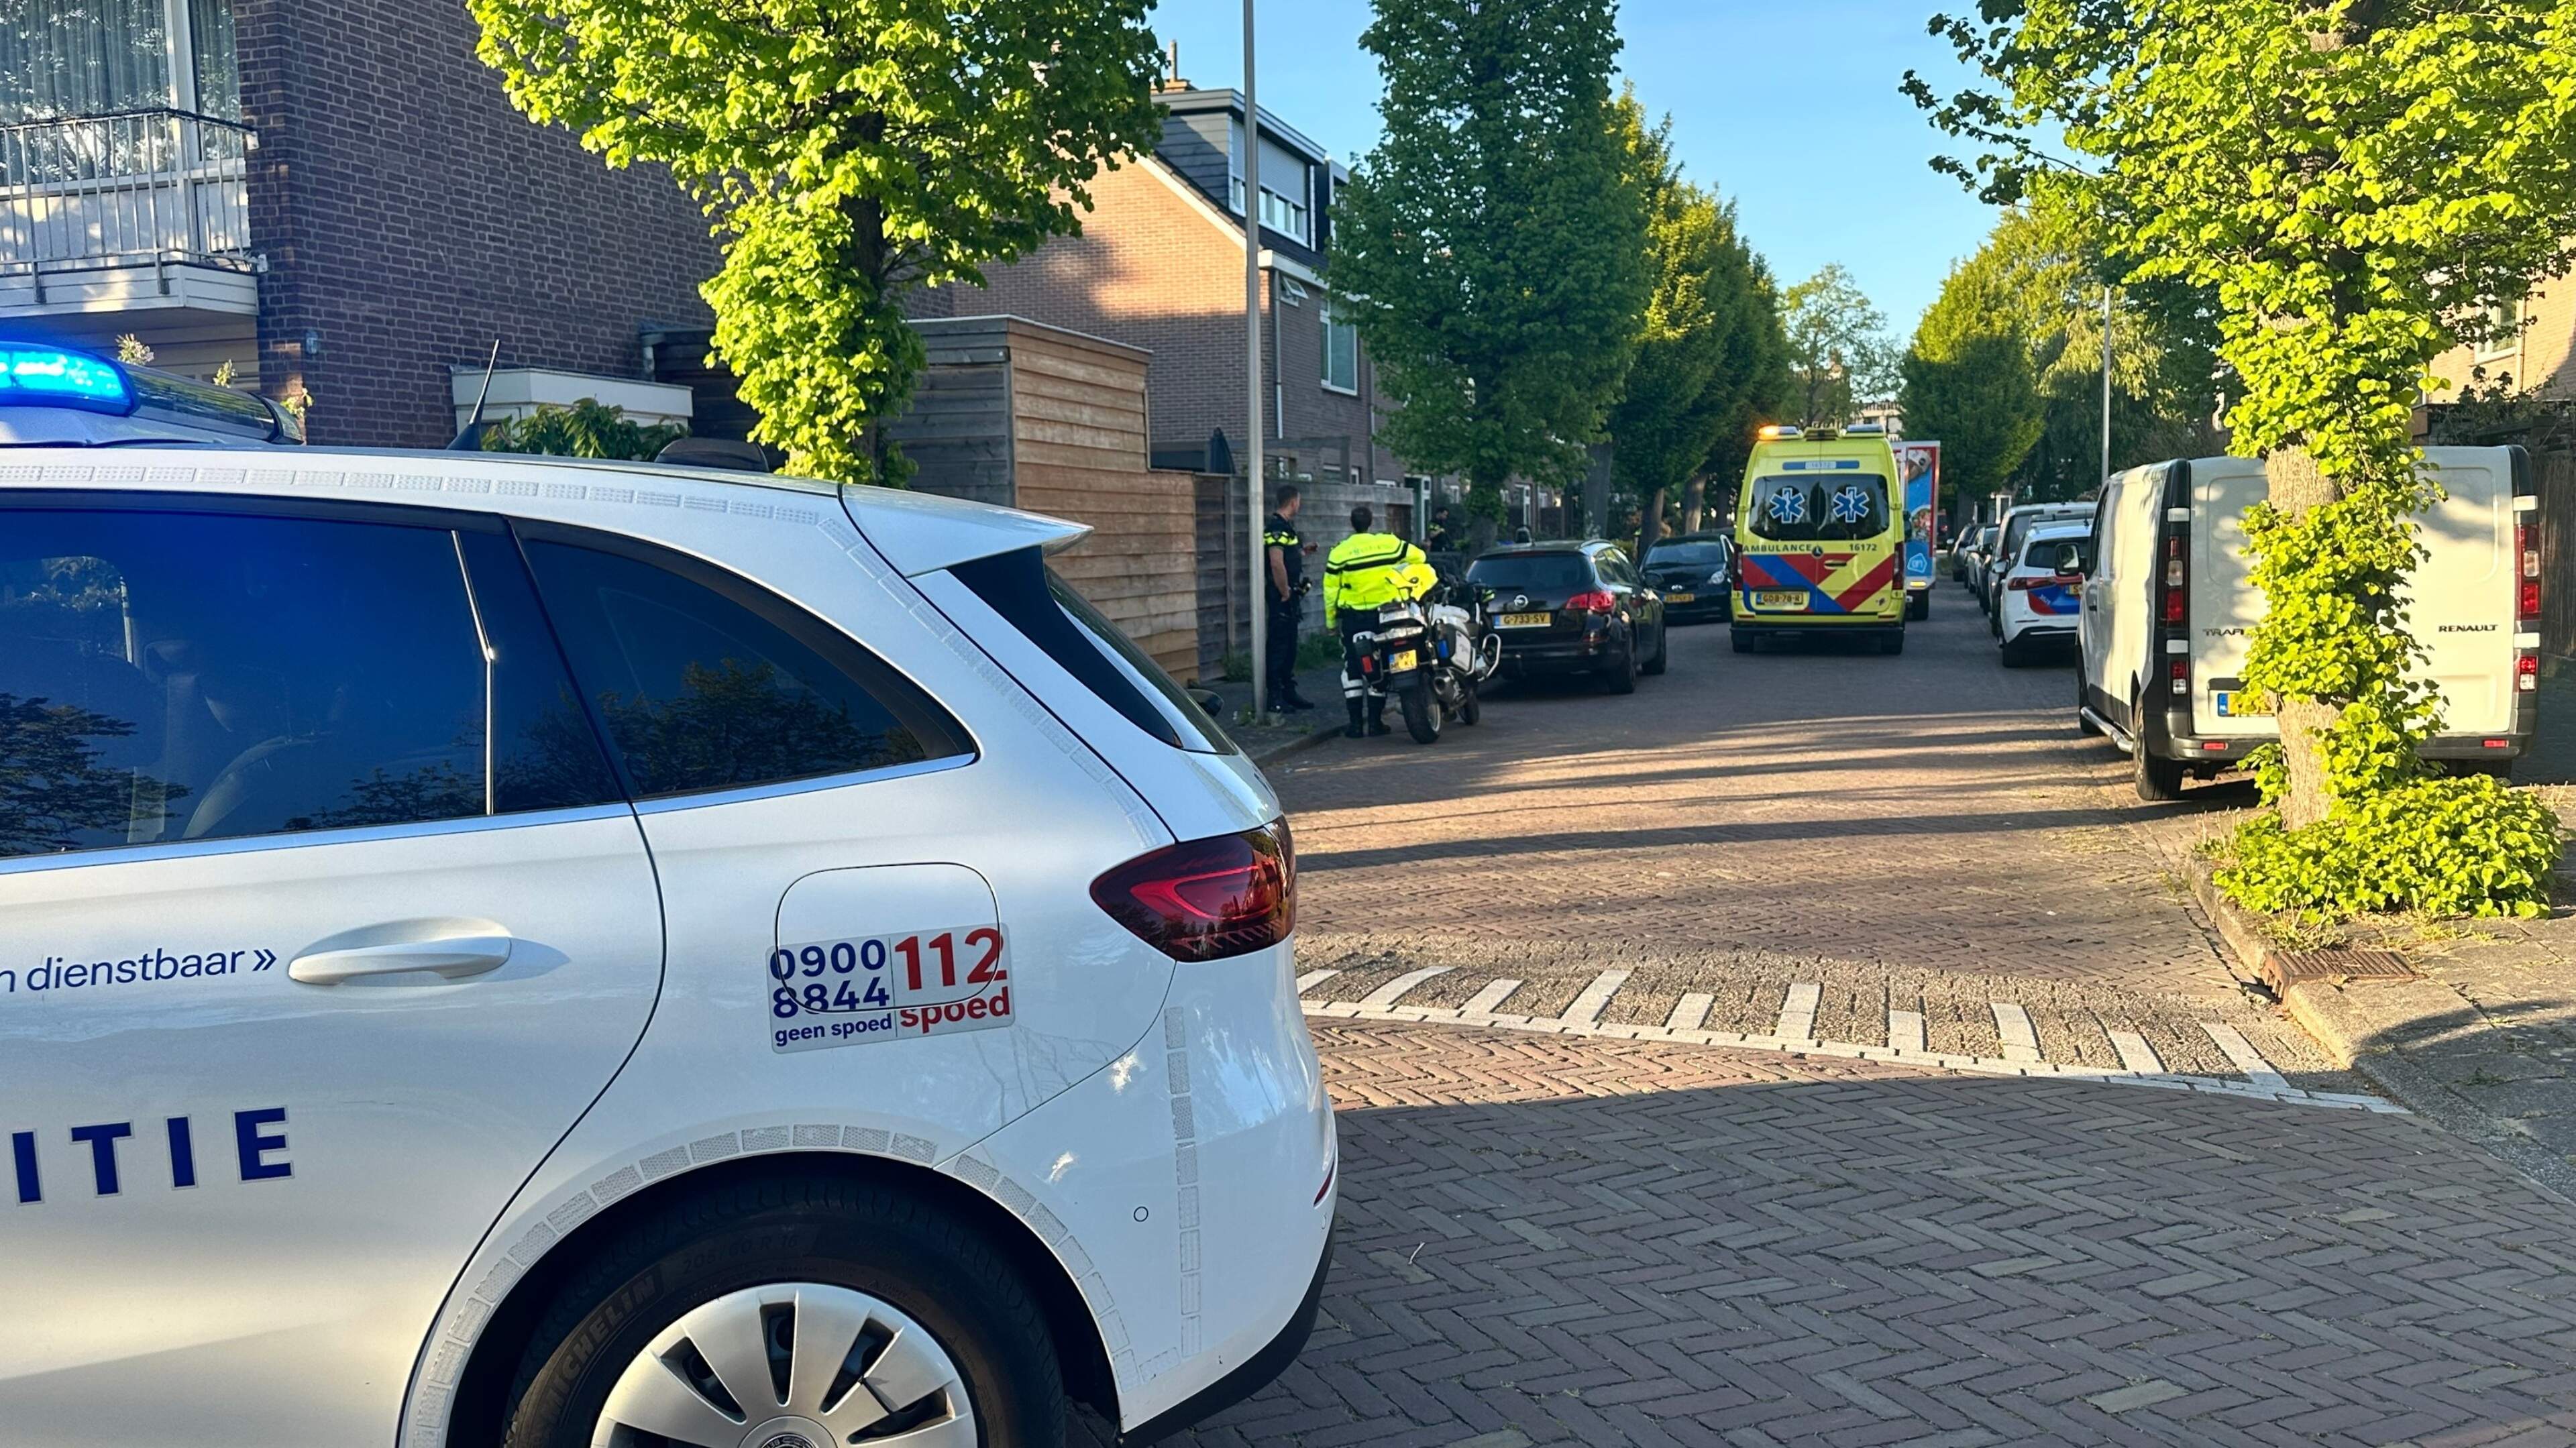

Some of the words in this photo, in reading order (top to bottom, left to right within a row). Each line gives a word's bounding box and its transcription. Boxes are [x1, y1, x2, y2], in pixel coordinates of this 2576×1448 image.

[1743, 544, 1812, 553] AMBULANCE
[1849, 543, 1878, 551] 16172
[1503, 614, 1546, 624] G-733-SV
[2203, 628, 2245, 636] TRAFI
[2438, 624, 2498, 632] RENAULT
[26, 946, 245, 991] dienstbaar
[769, 938, 886, 980] 0900
[894, 928, 1008, 991] 112
[772, 977, 890, 1019] 8844
[899, 986, 1010, 1034] spoed
[775, 1023, 825, 1048] geen
[831, 1013, 892, 1040] spoed
[539, 1274, 656, 1420] MICHELIN
